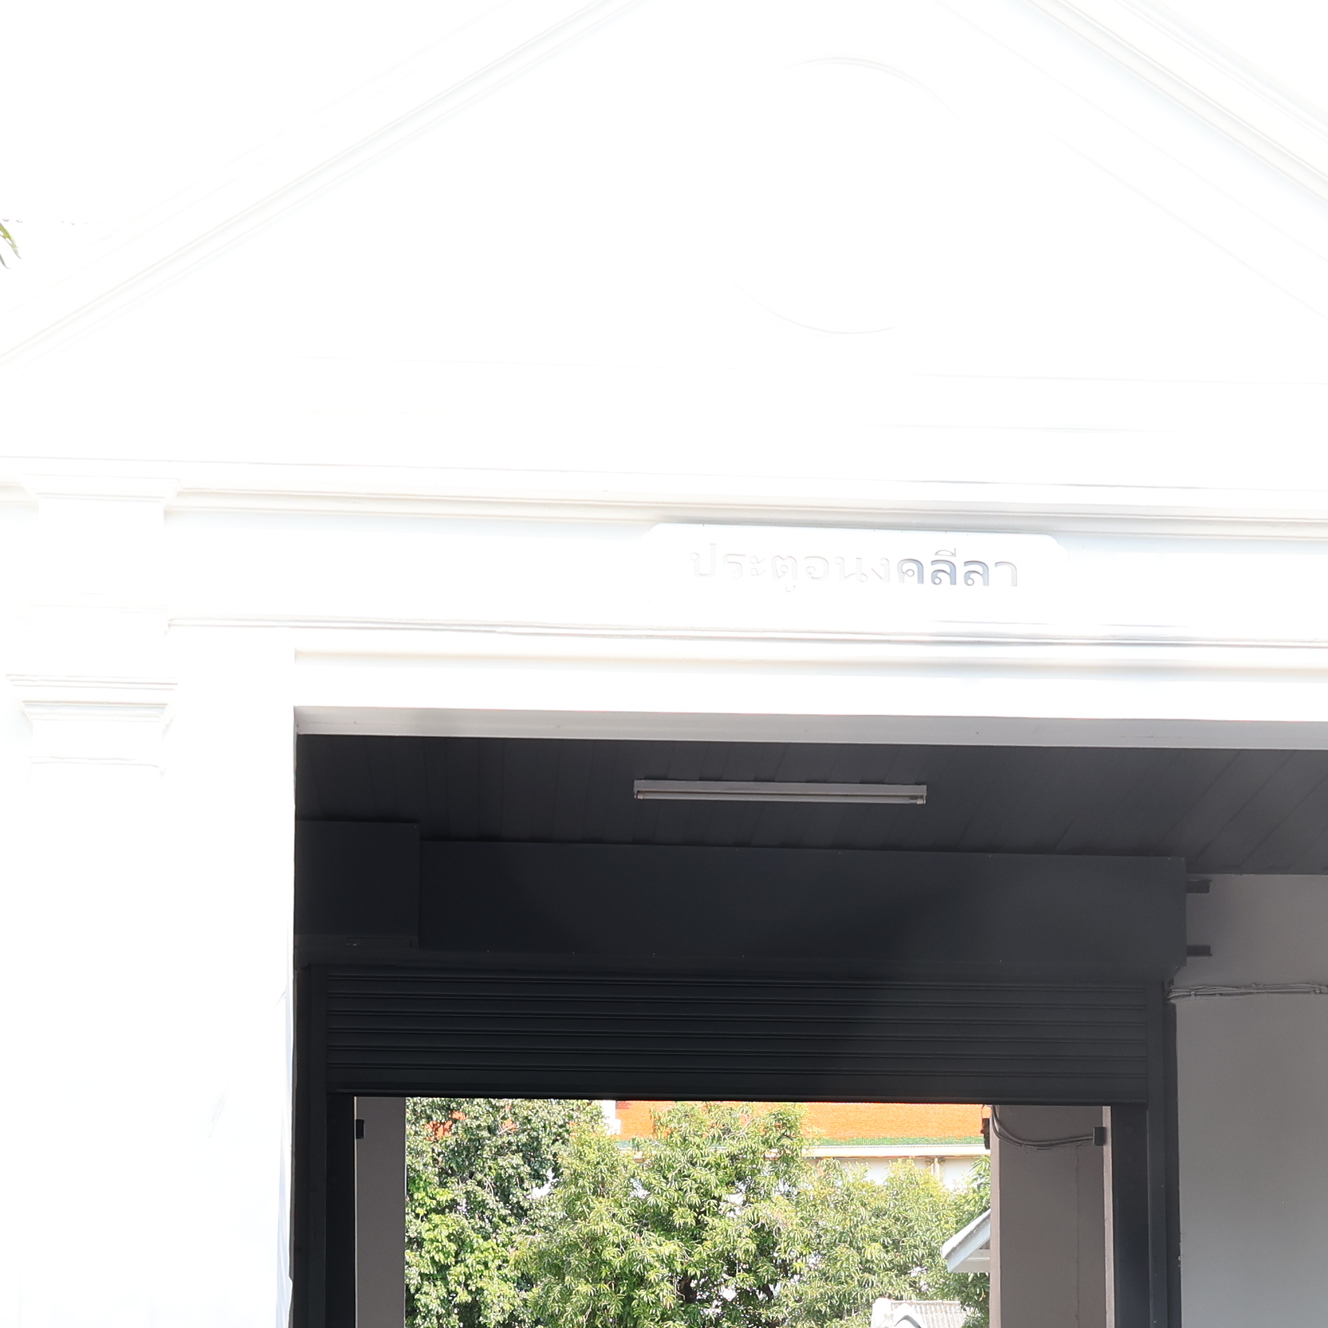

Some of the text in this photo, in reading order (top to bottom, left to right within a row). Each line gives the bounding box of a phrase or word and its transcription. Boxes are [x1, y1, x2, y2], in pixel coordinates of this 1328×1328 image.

[689, 542, 1019, 592] ประตูอนงคลีลา
